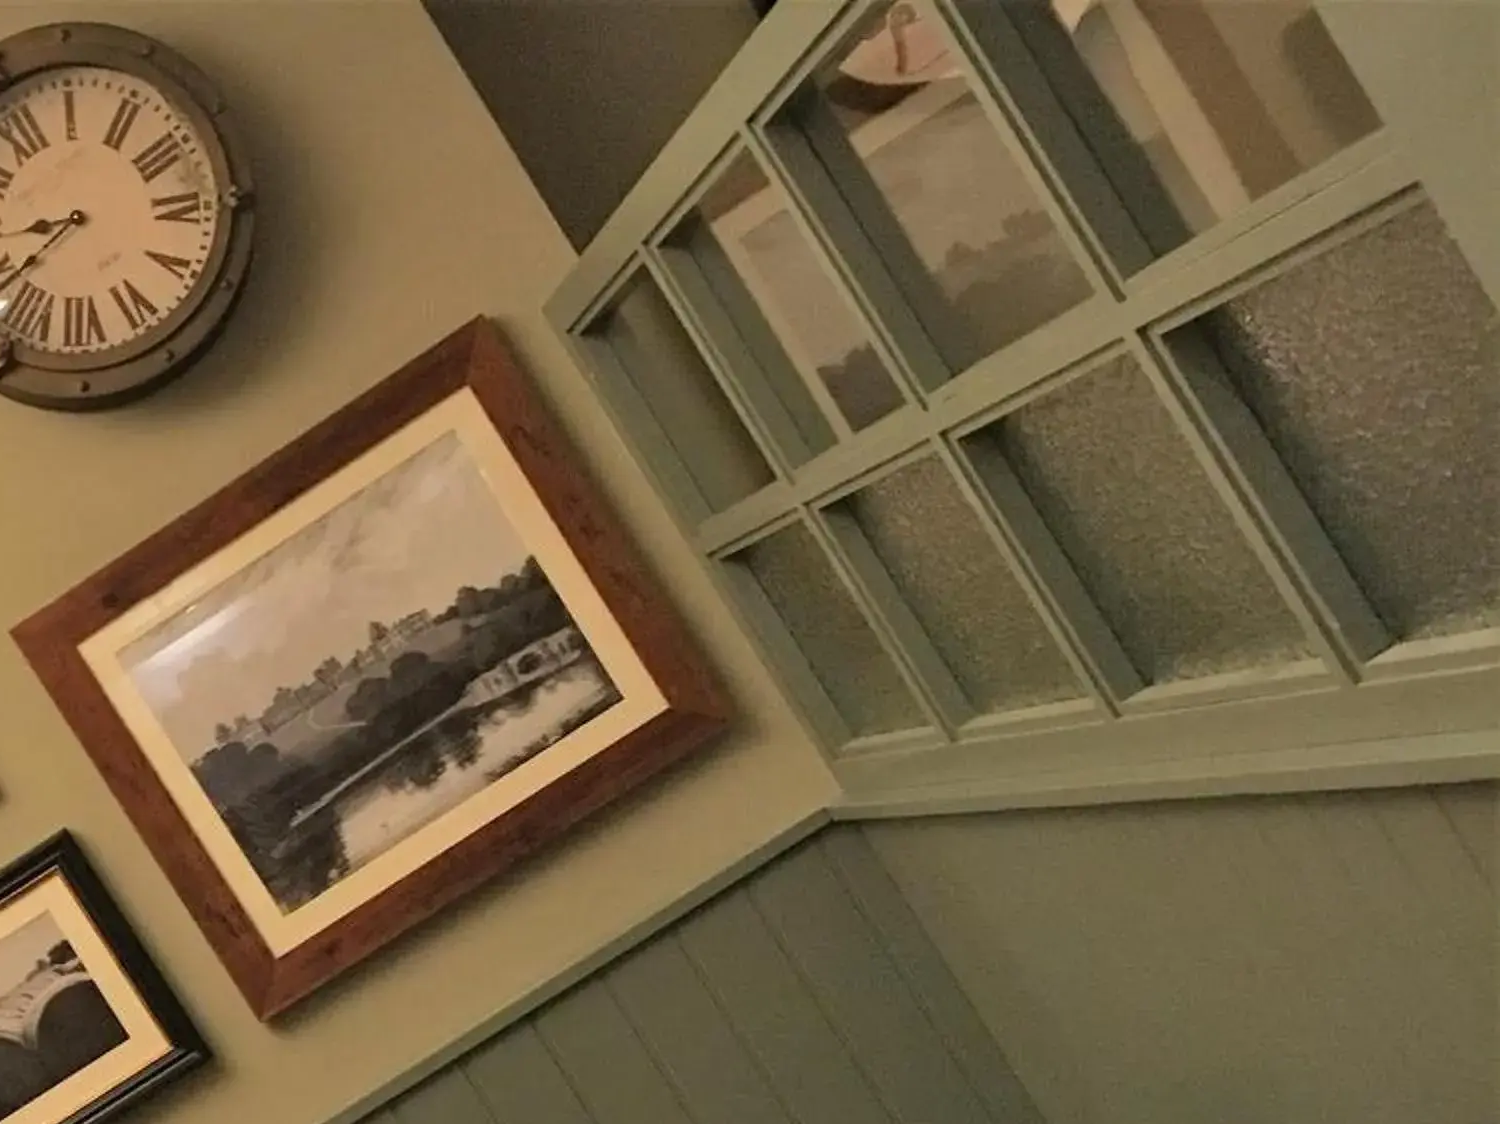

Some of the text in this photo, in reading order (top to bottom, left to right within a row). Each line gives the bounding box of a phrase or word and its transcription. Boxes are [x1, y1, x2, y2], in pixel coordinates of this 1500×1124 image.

[102, 96, 141, 151] II
[131, 131, 183, 184] III
[143, 249, 192, 280] V
[63, 294, 107, 348] VII
[107, 278, 160, 331] VI
